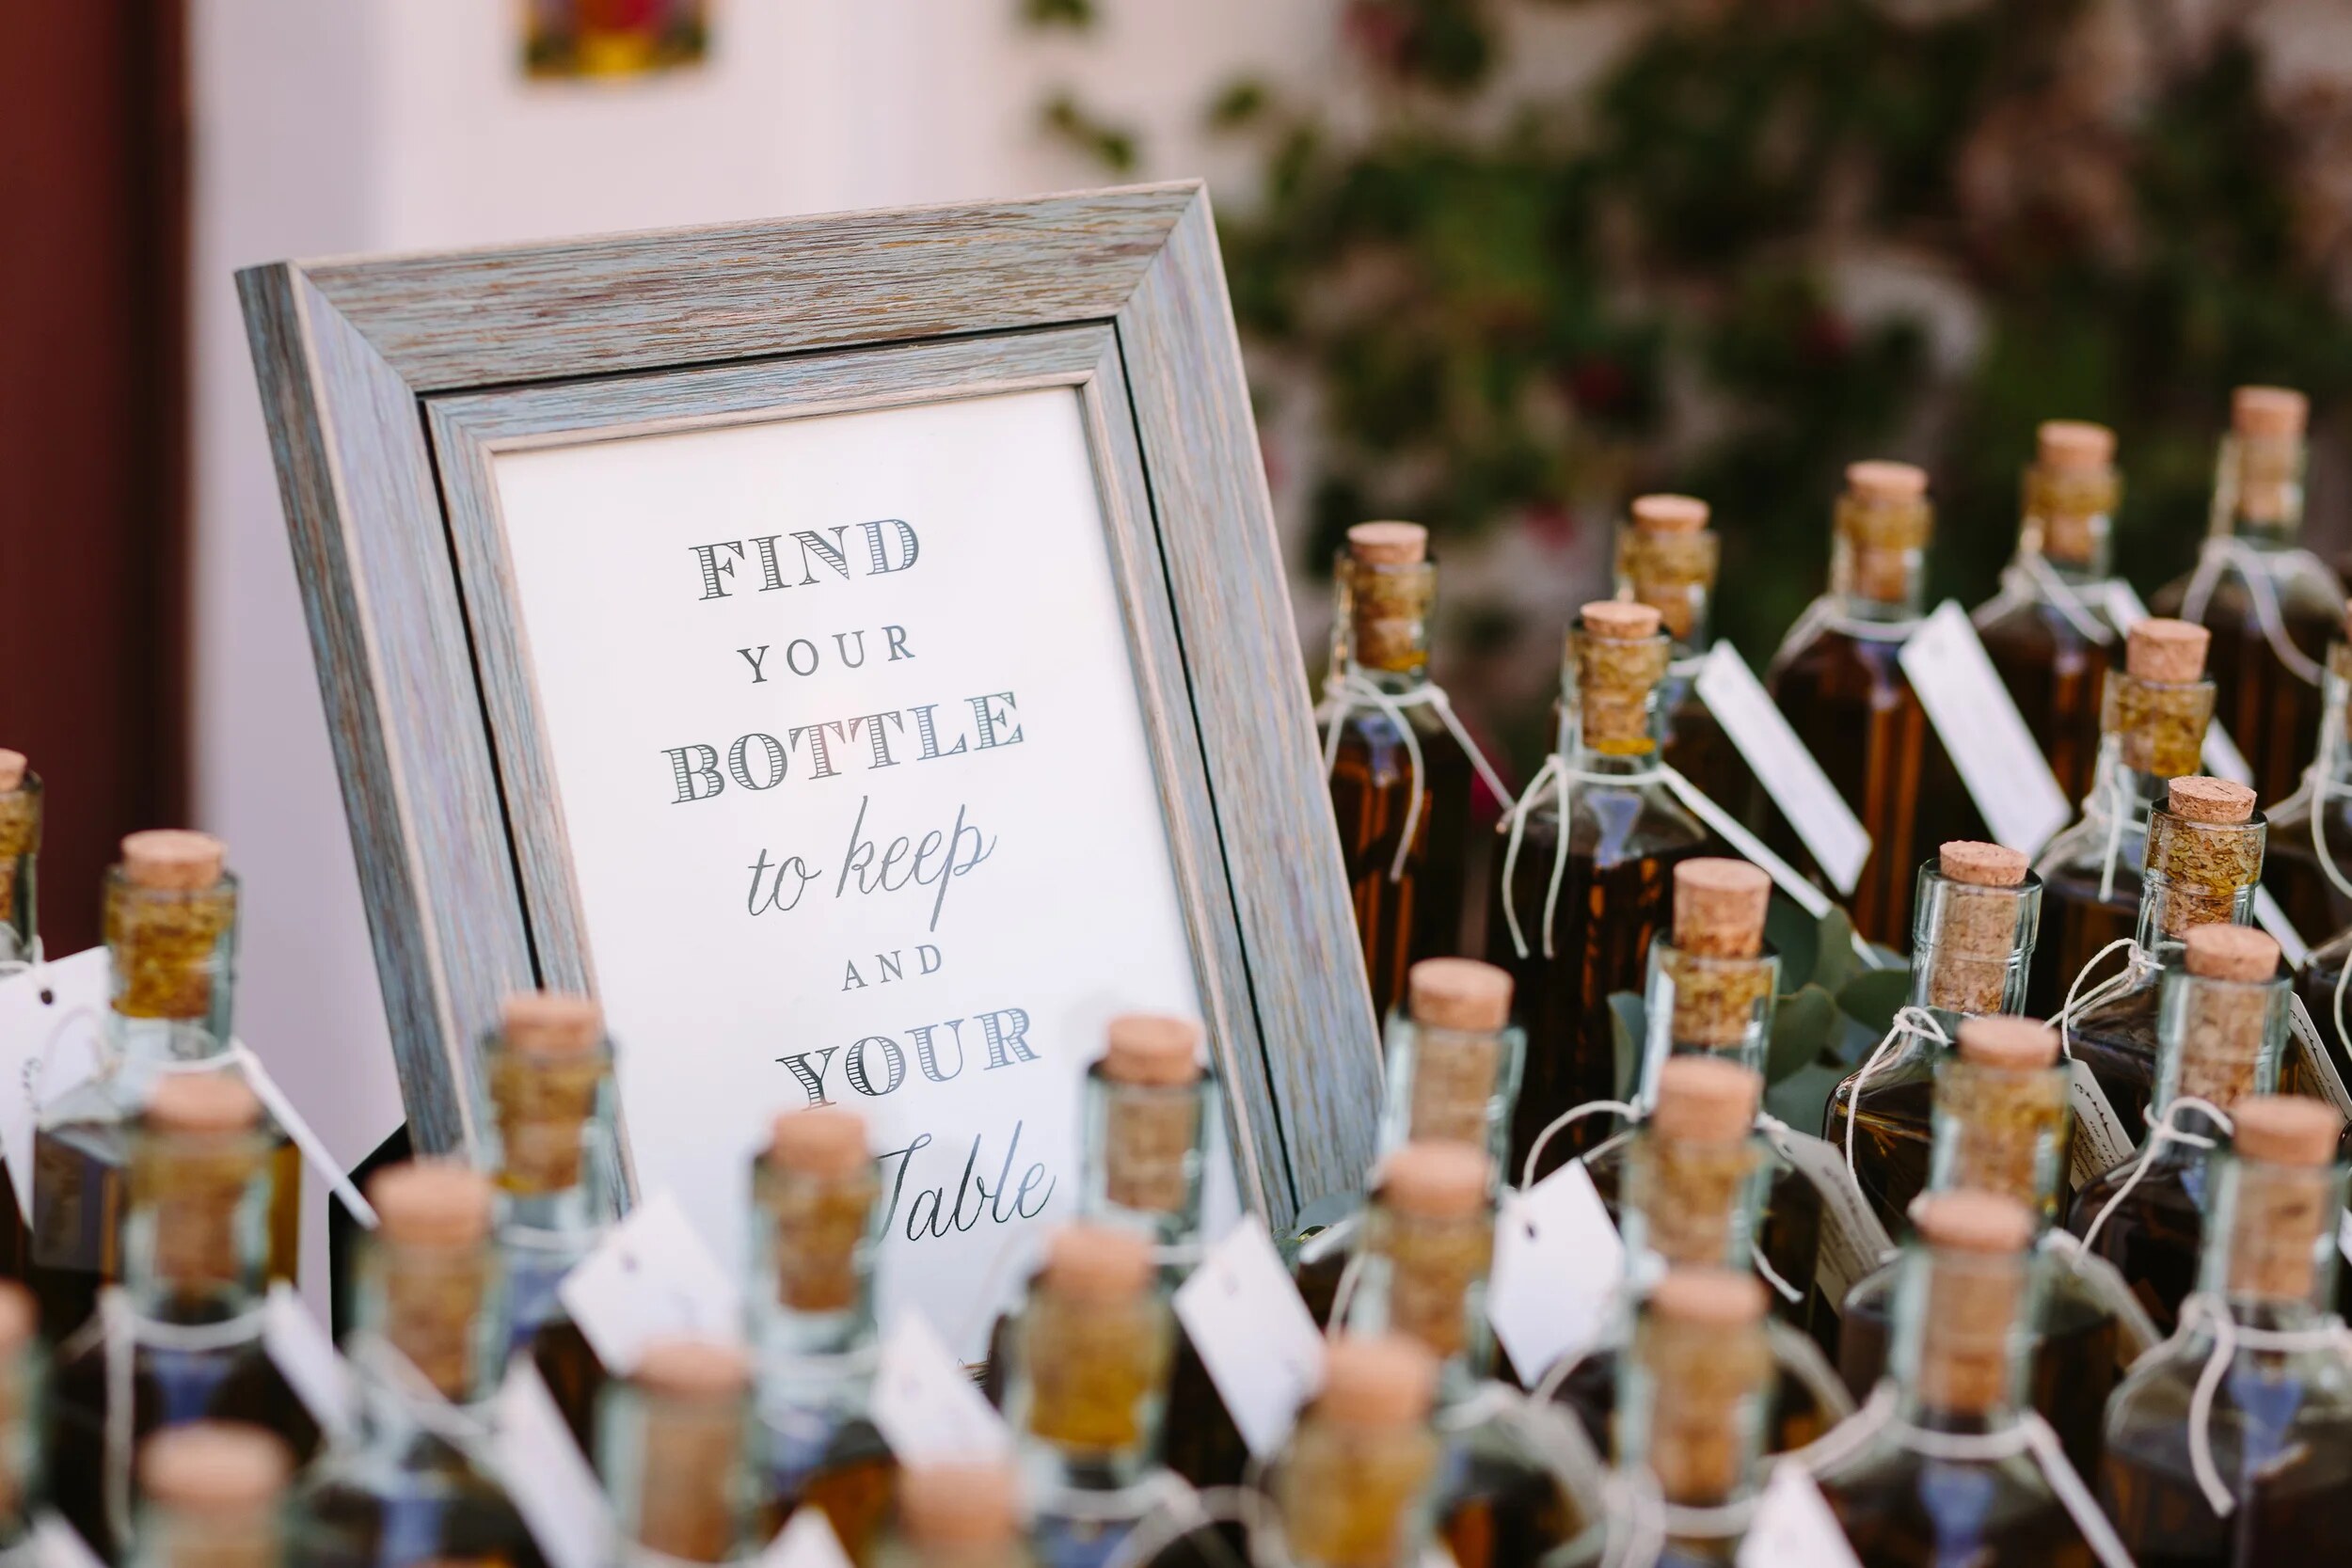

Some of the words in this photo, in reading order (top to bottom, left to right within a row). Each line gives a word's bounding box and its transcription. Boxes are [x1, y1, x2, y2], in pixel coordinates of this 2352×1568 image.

[688, 518, 920, 601] FIND
[737, 625, 915, 684] YOUR
[660, 691, 1025, 804] BOTTLE
[747, 848, 822, 916] to
[835, 795, 997, 932] keep
[841, 943, 943, 991] AND
[775, 1007, 1041, 1112] YOUR
[875, 1119, 1057, 1245] Table
